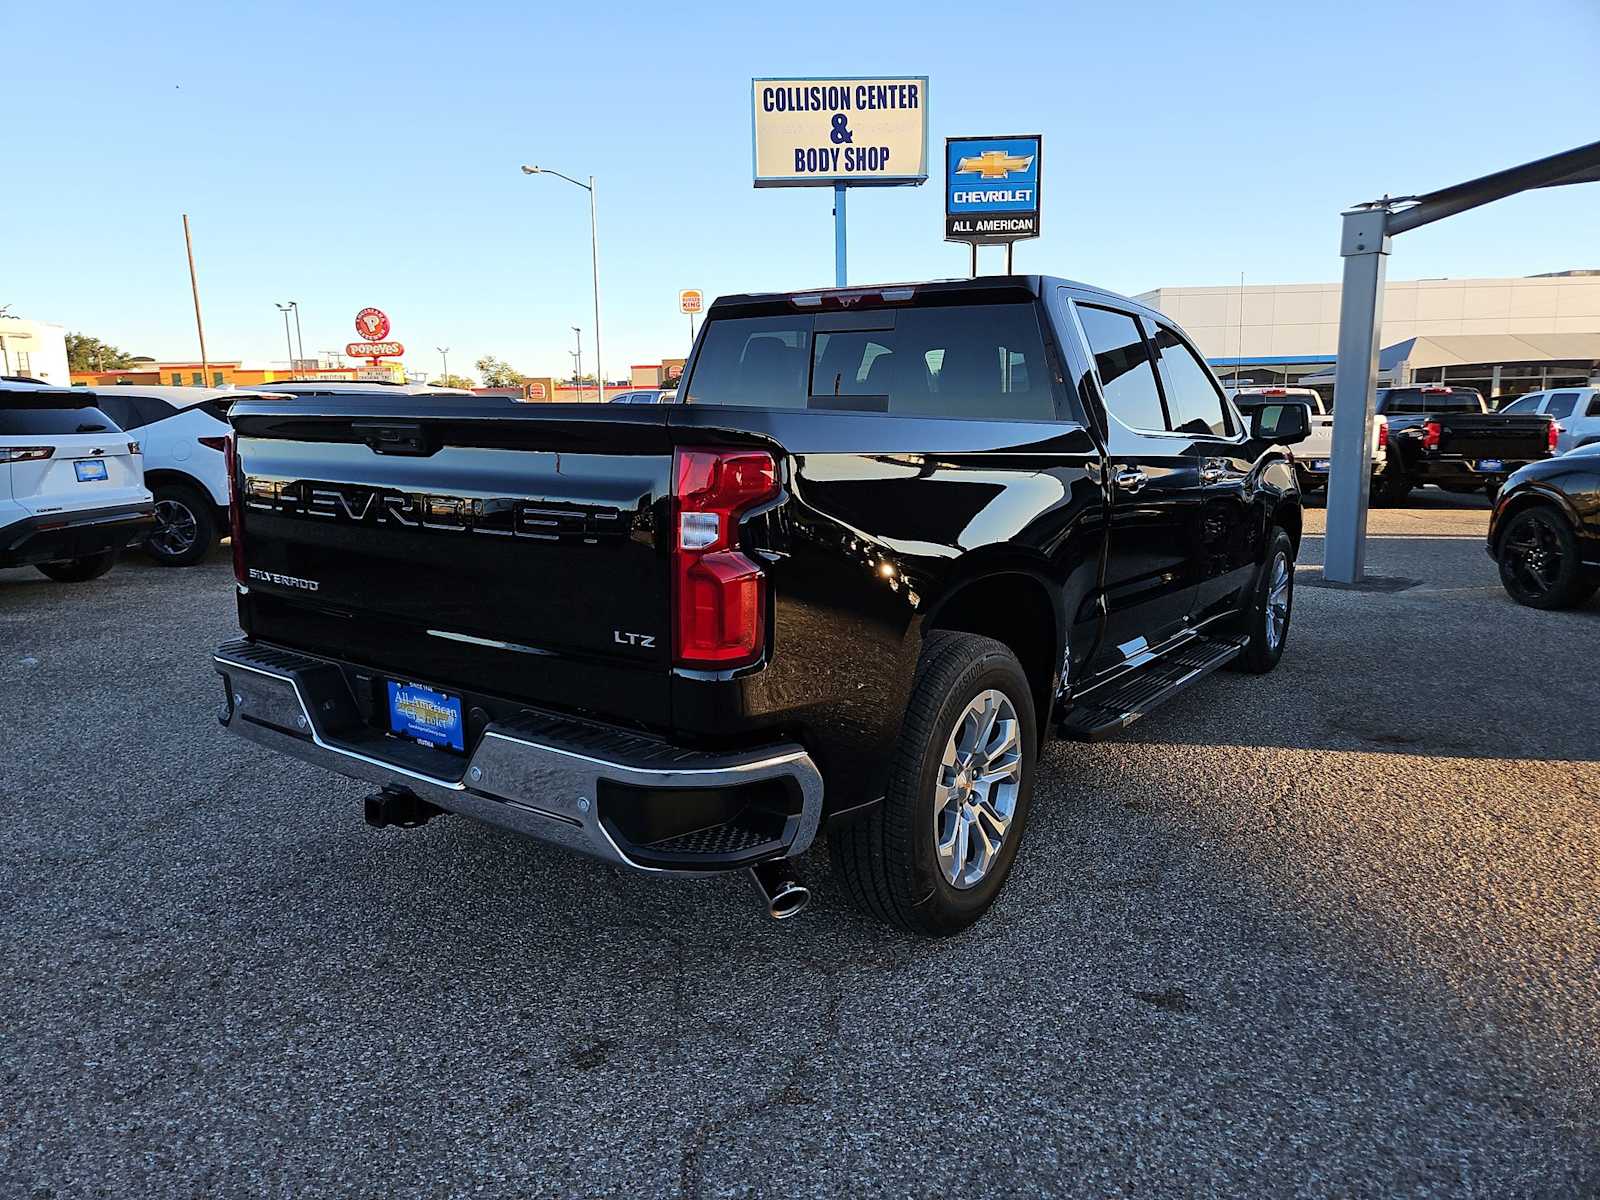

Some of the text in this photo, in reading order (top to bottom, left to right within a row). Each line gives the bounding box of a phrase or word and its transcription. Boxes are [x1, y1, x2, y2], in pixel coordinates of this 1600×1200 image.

[763, 84, 919, 112] COLLISION CENTER
[830, 113, 853, 144] &
[794, 147, 890, 172] BODY SHOP
[953, 189, 1033, 203] CHEVROLET
[952, 219, 1033, 232] ALL AMERICAN
[245, 477, 620, 544] CHEVROLET
[248, 568, 320, 591] SILVERADO
[614, 630, 656, 648] LTZ
